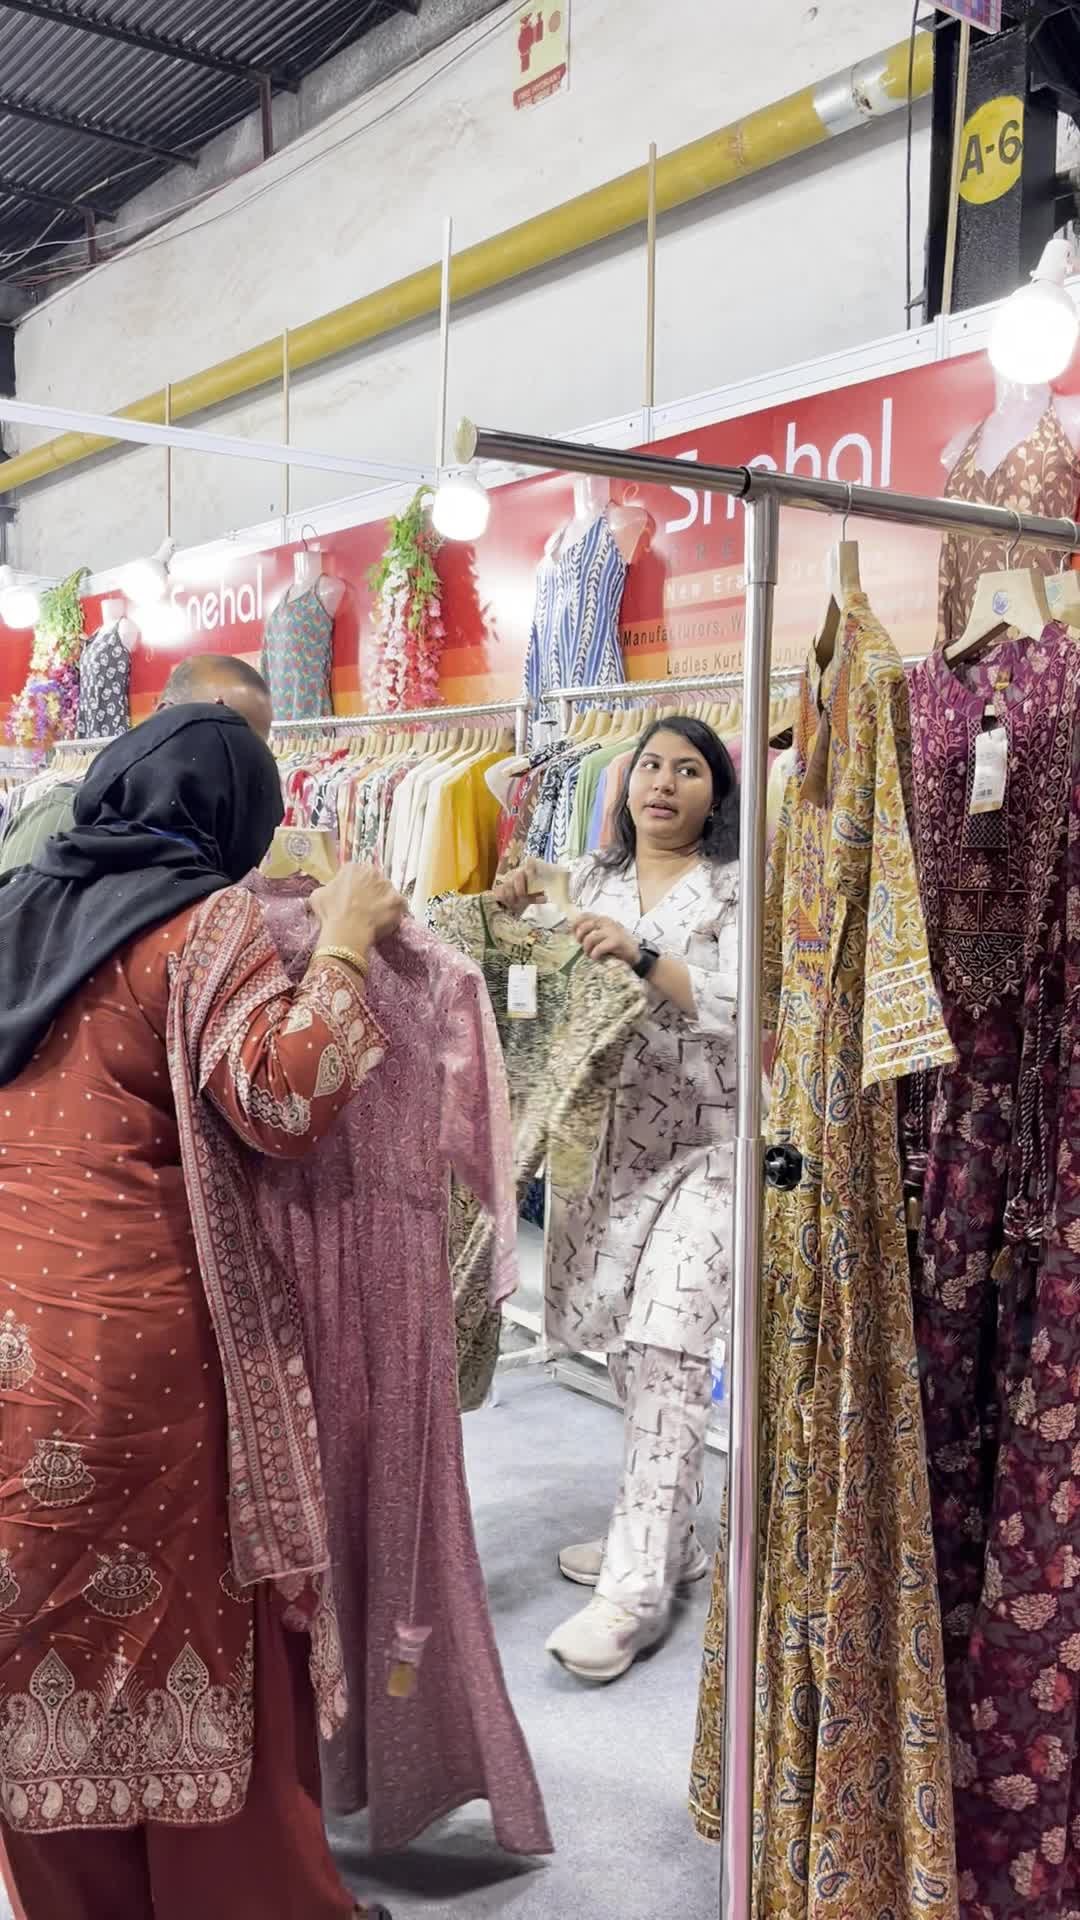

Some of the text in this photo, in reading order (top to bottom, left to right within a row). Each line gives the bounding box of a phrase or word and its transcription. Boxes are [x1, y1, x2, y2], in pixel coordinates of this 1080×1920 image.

[960, 119, 1022, 183] A-6
[665, 397, 893, 534] Snhal
[666, 654, 708, 676] Ladies
[713, 649, 743, 670] Kurt
